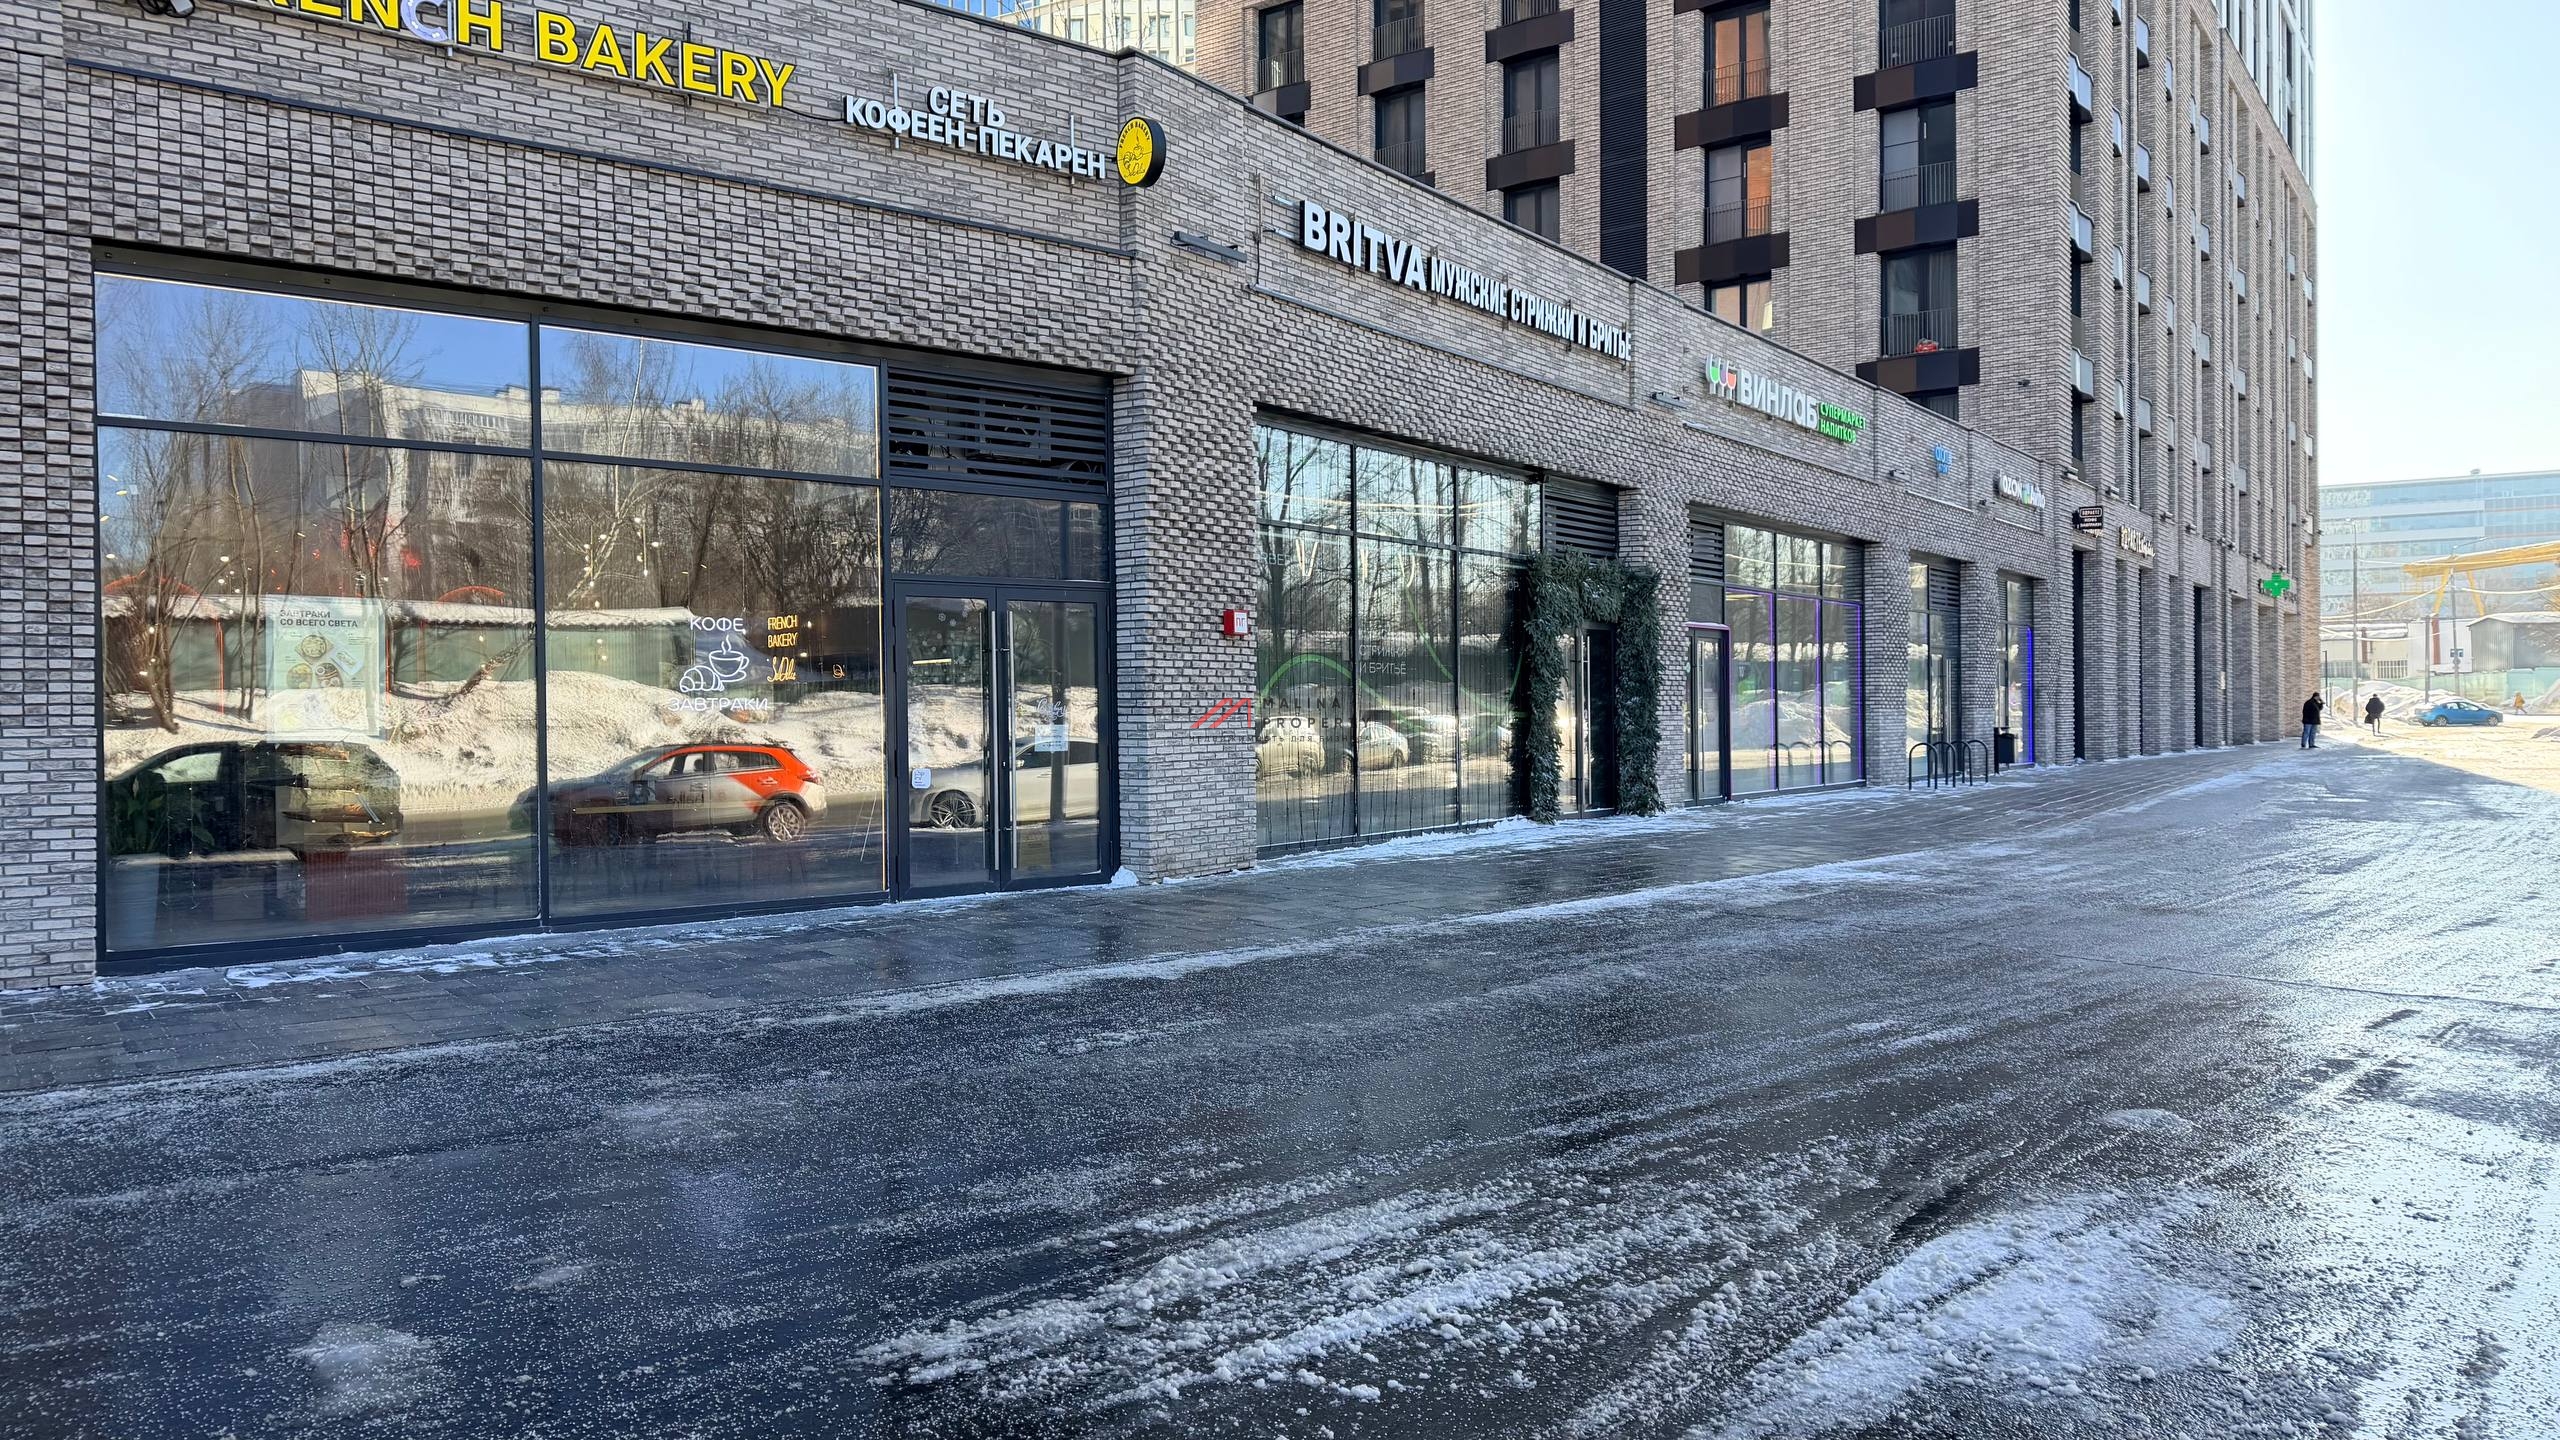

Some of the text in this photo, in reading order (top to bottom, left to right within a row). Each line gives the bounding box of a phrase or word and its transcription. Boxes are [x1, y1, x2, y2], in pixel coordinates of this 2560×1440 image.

[534, 10, 797, 108] BAKERY
[928, 85, 1006, 128] СЕТЬ
[843, 94, 1106, 179] КОФЕЕН-ПЕКАРЕН
[1302, 200, 1427, 292] BRITVA
[1430, 257, 1508, 318] МУЖСКИЕ
[1510, 287, 1575, 342] СТРИЖКИ
[1577, 313, 1588, 346] И
[1819, 402, 1867, 430] СУПЕРМАРКЕТ
[1819, 418, 1857, 445] НАПИТКОВ
[279, 609, 331, 619] ЗАВТРАКИ
[280, 618, 358, 628] СО ВСЕГО СВЕТА
[690, 616, 744, 632] КОФЕ
[767, 614, 798, 631] FRENCH
[767, 632, 798, 649] BAKERY
[667, 697, 769, 712] ЗАВТРАКИ
